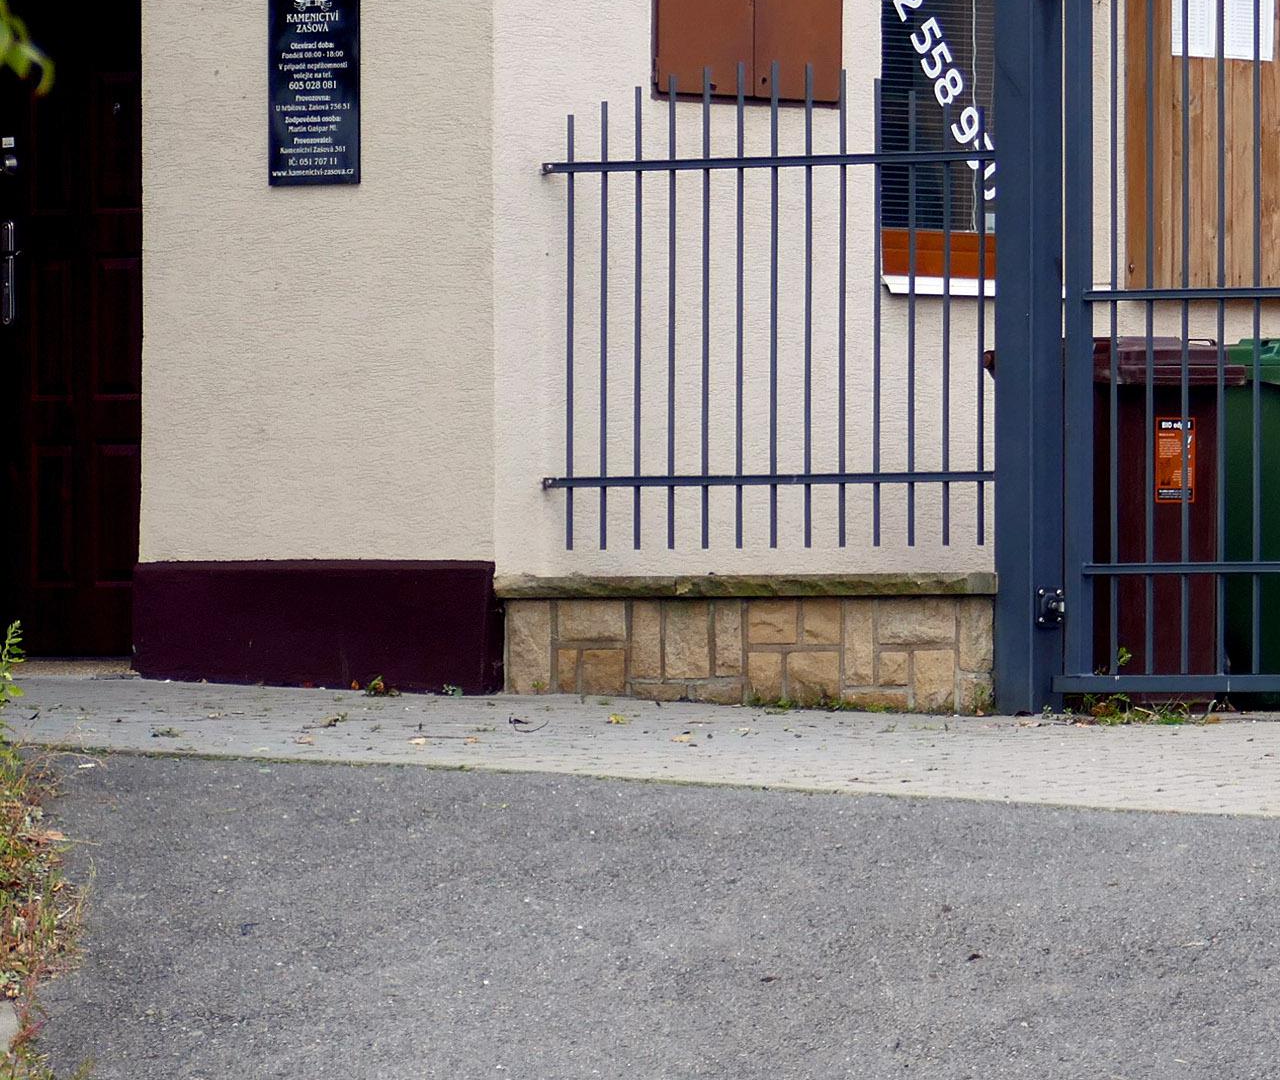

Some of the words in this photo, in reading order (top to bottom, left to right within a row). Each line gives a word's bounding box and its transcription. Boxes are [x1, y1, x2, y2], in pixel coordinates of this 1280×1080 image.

[286, 10, 339, 23] KAMENICTVÍ
[296, 22, 329, 33] ZAŠOVÁ
[326, 50, 344, 58] 18:00
[910, 16, 963, 108] 558
[293, 72, 313, 80] volejte
[288, 81, 304, 90] 605
[305, 81, 320, 89] 028
[322, 80, 337, 89] 081
[288, 125, 307, 133] Martin
[299, 158, 312, 166] 051
[314, 157, 328, 165] 707
[329, 157, 337, 165] 11
